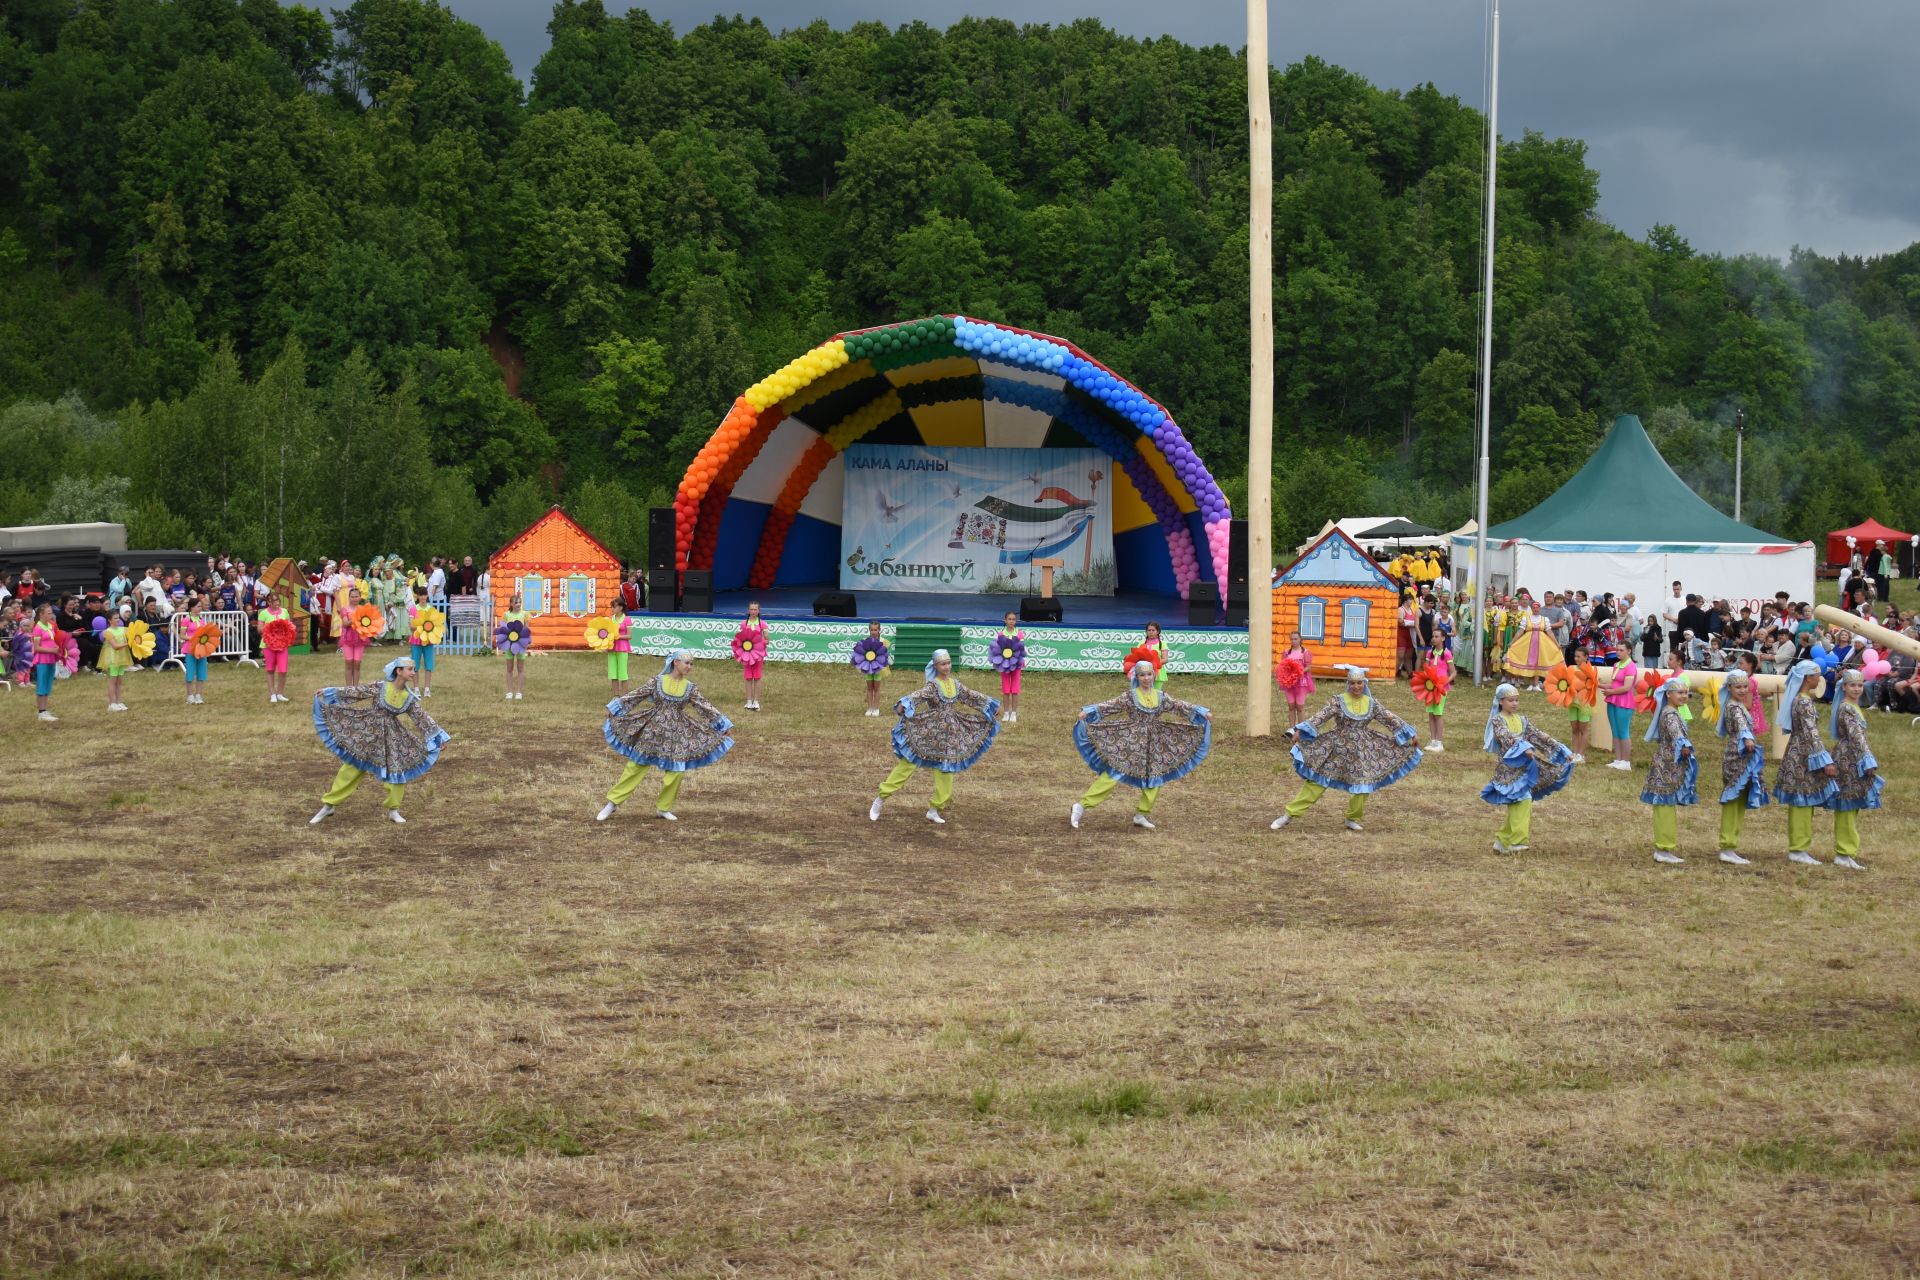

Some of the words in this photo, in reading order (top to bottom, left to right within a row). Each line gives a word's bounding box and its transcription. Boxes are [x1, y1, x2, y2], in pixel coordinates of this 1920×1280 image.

[852, 457, 891, 469] КАМА
[896, 459, 949, 471] АЛАНЫ
[847, 556, 976, 583] Сабантуй
